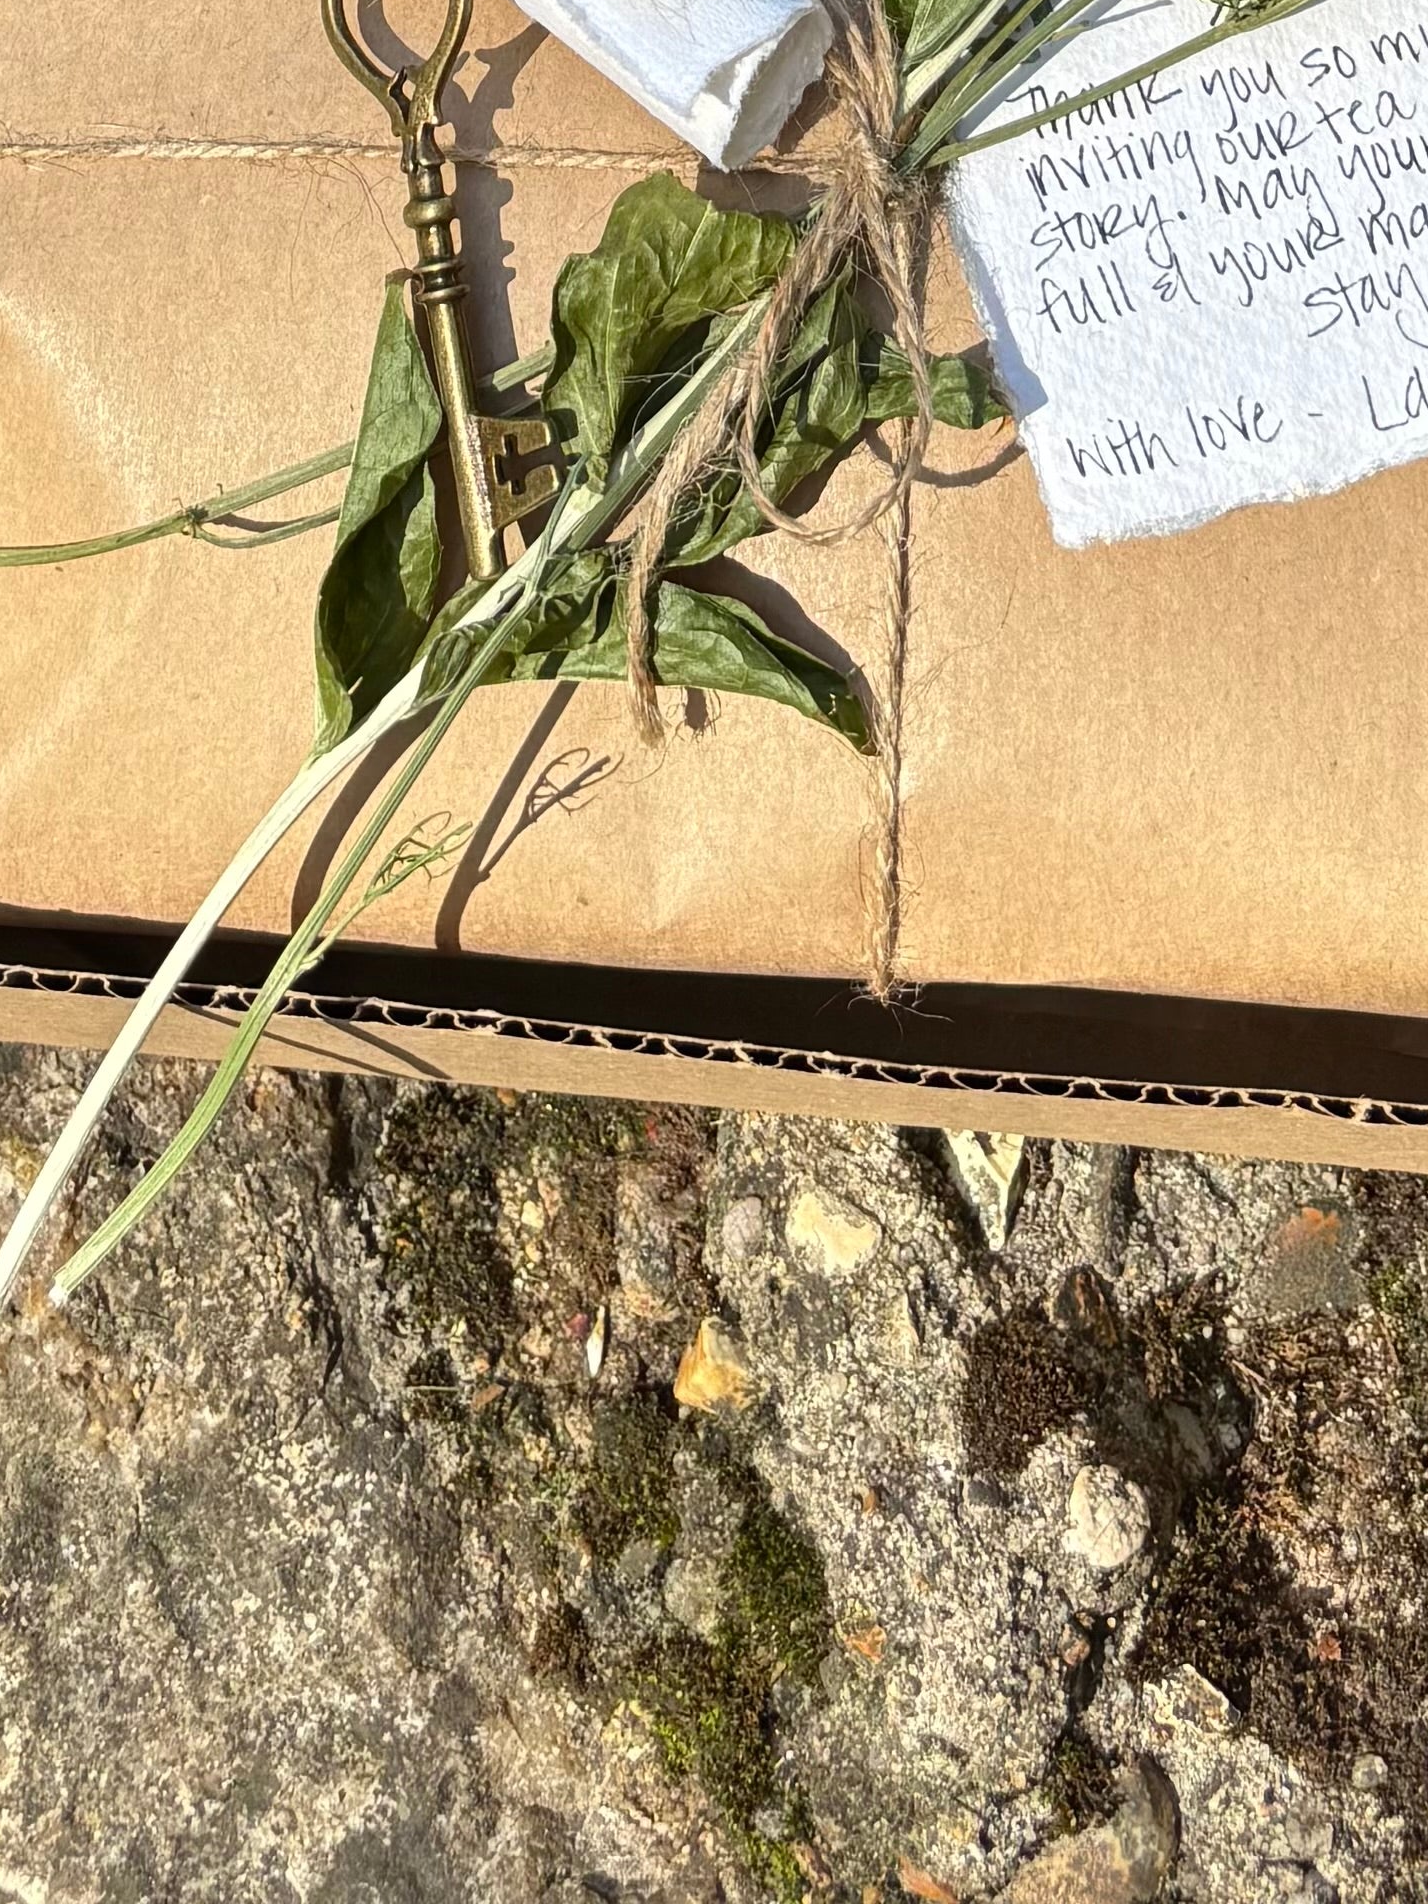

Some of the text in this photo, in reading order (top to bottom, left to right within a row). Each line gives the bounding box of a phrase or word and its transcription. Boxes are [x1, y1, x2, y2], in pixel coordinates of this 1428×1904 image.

[1004, 70, 1183, 141] Thank
[1199, 60, 1287, 133] you
[1300, 47, 1357, 87] so
[1018, 128, 1207, 211] inviting
[1315, 90, 1418, 144] tea
[1035, 259, 1137, 333] full
[1066, 417, 1180, 478] with
[1185, 394, 1284, 458] love
